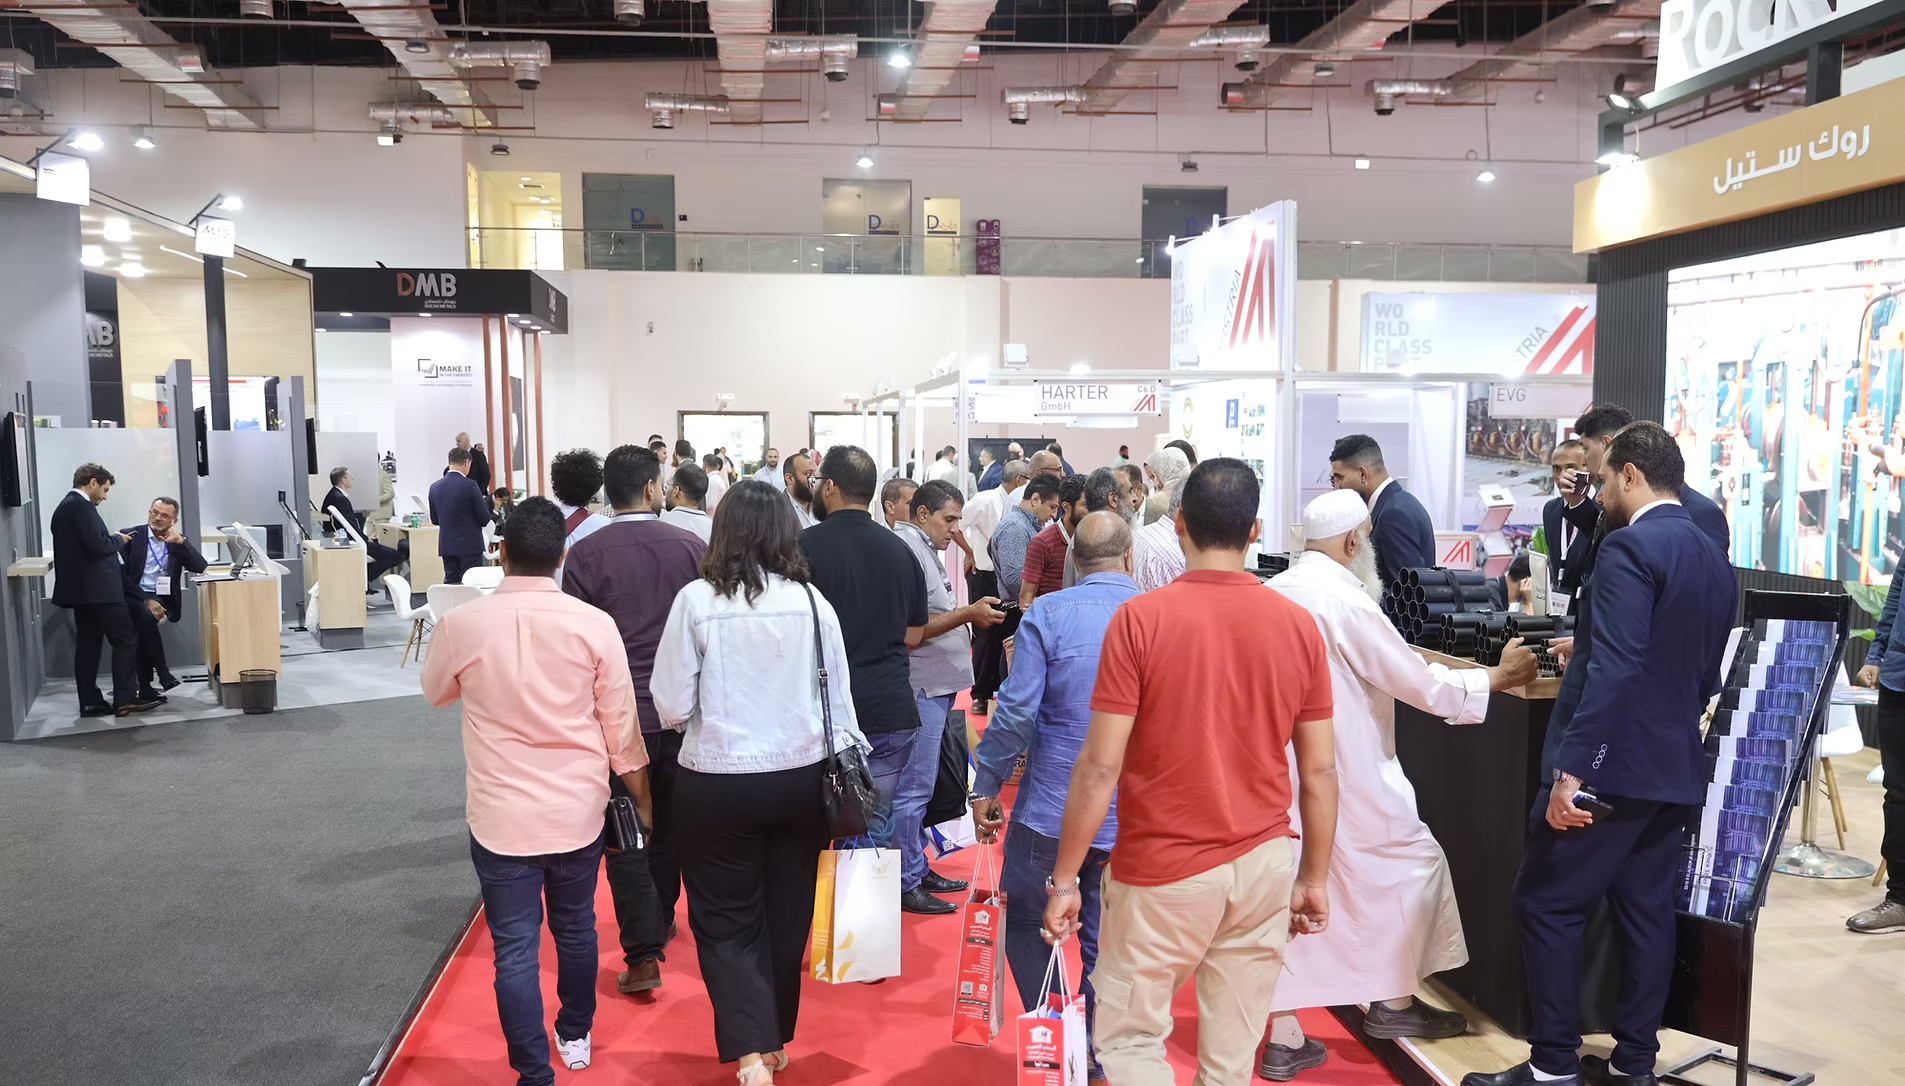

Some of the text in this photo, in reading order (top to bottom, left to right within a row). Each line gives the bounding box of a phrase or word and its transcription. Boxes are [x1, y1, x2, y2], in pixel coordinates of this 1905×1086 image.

[1713, 124, 1870, 195] روك ستيل
[396, 272, 457, 297] DMB
[1375, 303, 1404, 319] WO
[1375, 321, 1410, 337] RLD
[1042, 385, 1108, 400] HARTER
[1497, 388, 1526, 402] EVG
[1041, 402, 1071, 411] GmbH
